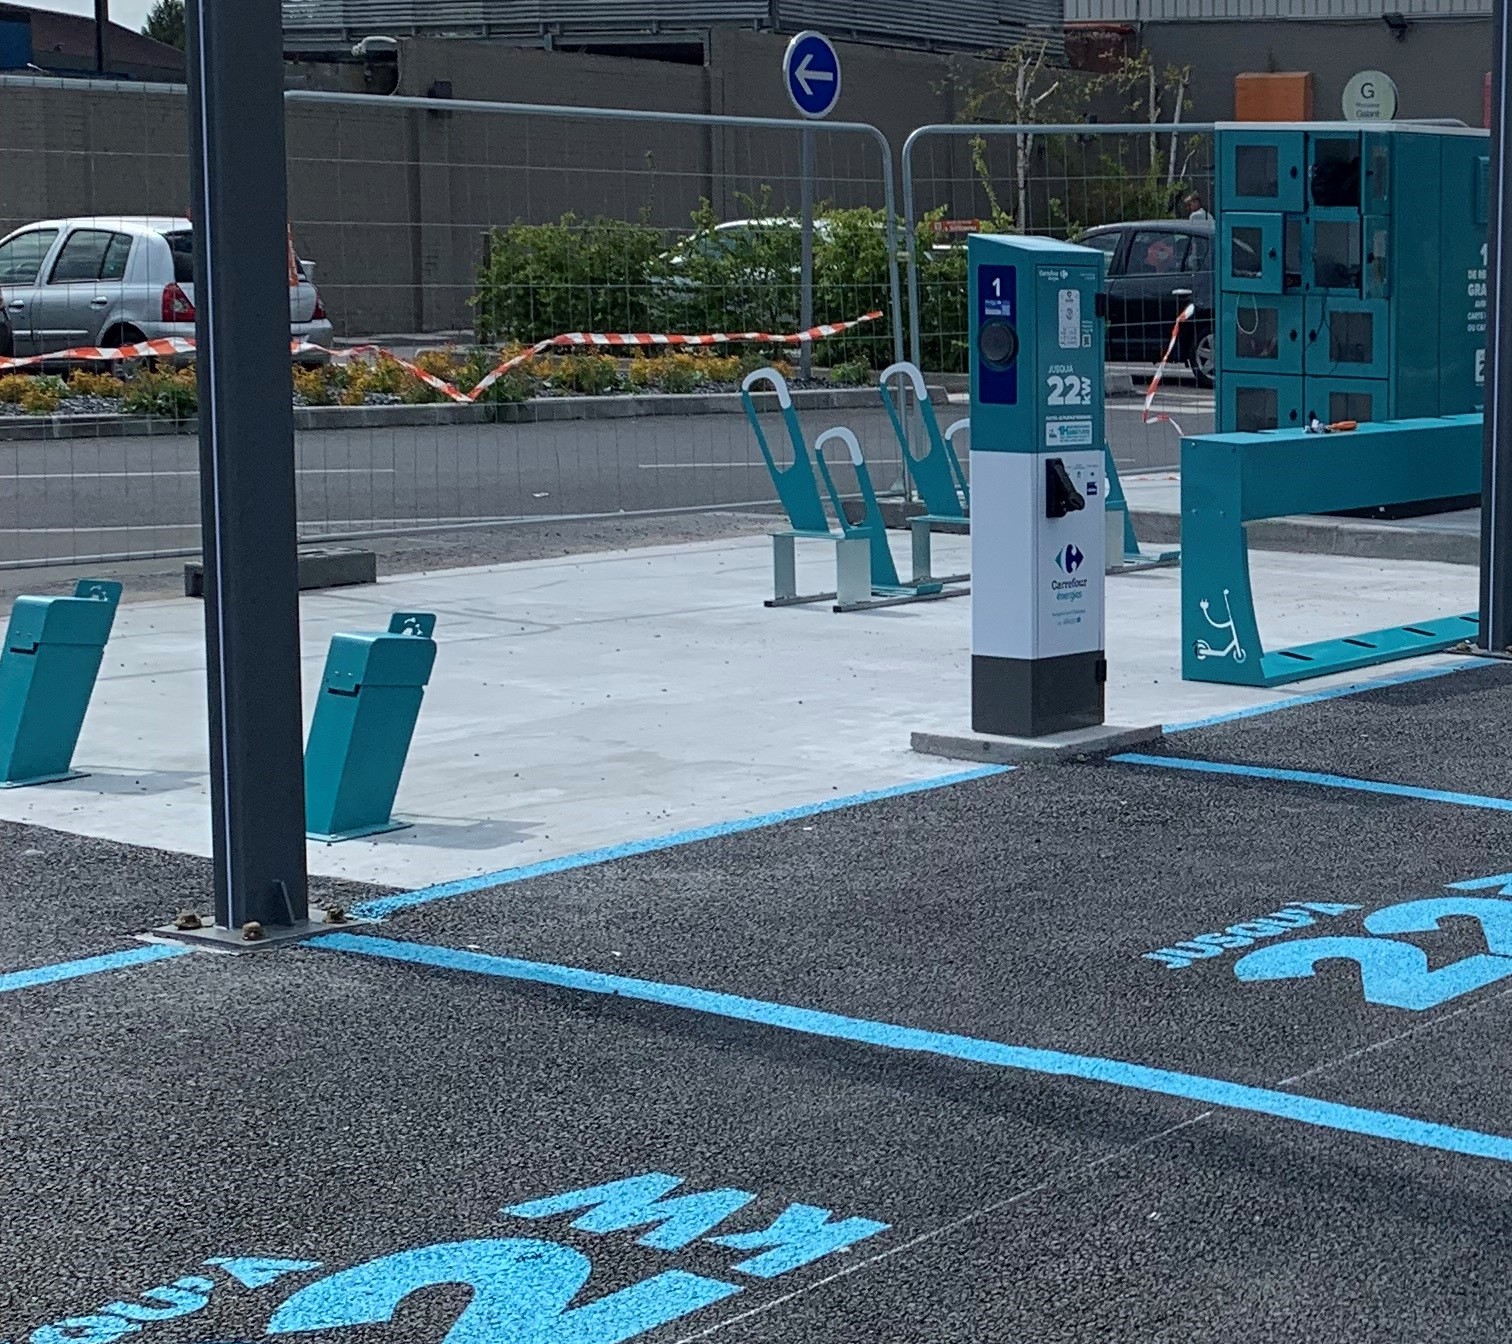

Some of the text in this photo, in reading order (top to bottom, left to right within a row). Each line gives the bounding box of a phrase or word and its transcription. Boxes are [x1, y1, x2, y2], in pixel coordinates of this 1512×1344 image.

[1361, 82, 1375, 99] G
[992, 277, 1001, 297] 1
[1047, 375, 1081, 406] 22
[1051, 577, 1088, 590] Carrefour
